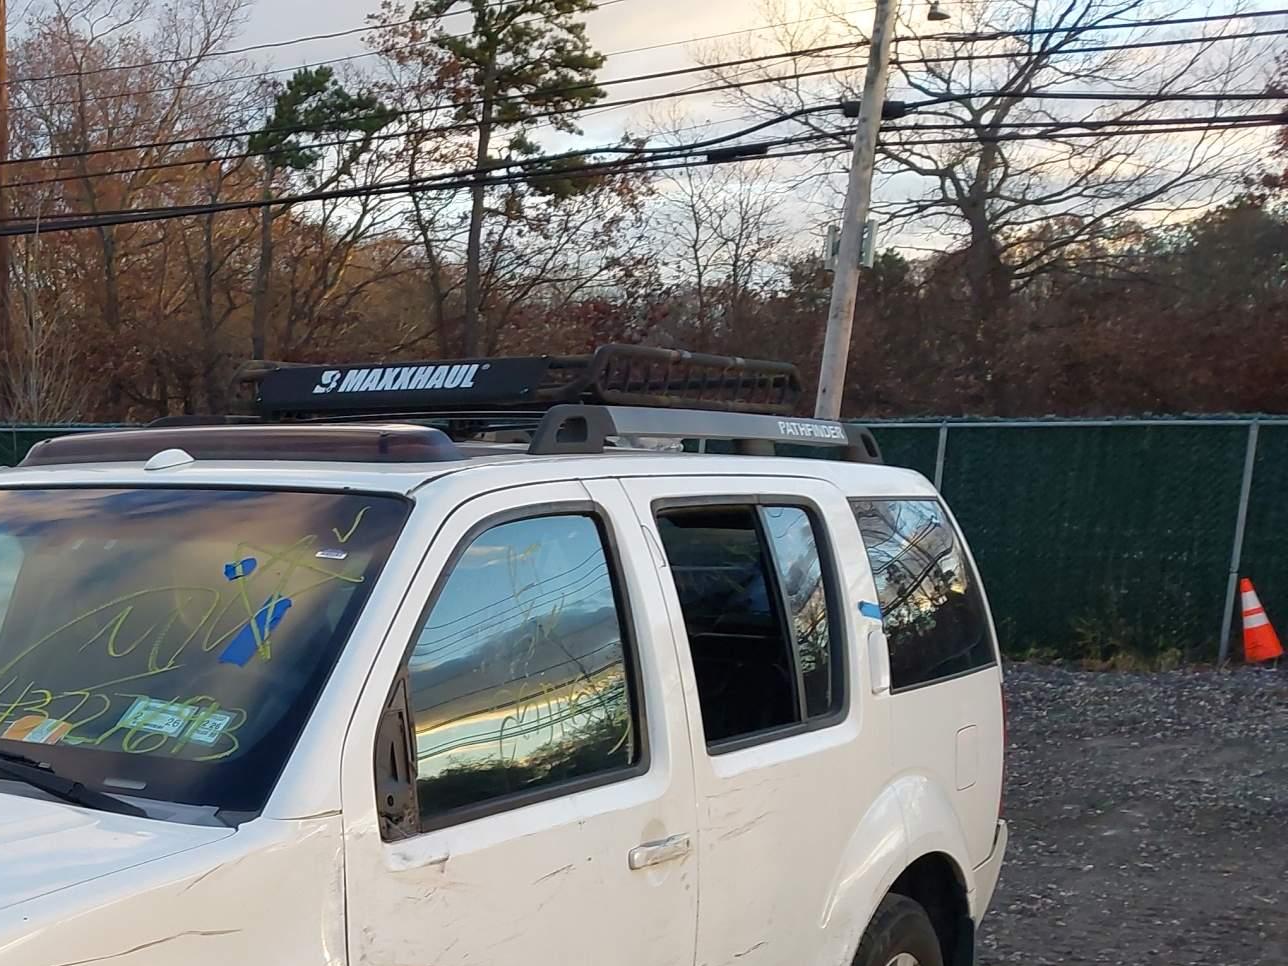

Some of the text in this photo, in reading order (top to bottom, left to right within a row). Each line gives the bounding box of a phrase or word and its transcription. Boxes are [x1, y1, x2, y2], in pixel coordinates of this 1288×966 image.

[337, 363, 480, 393] MAXXHAUL
[777, 421, 845, 440] PATHFINDER
[164, 717, 182, 728] 26
